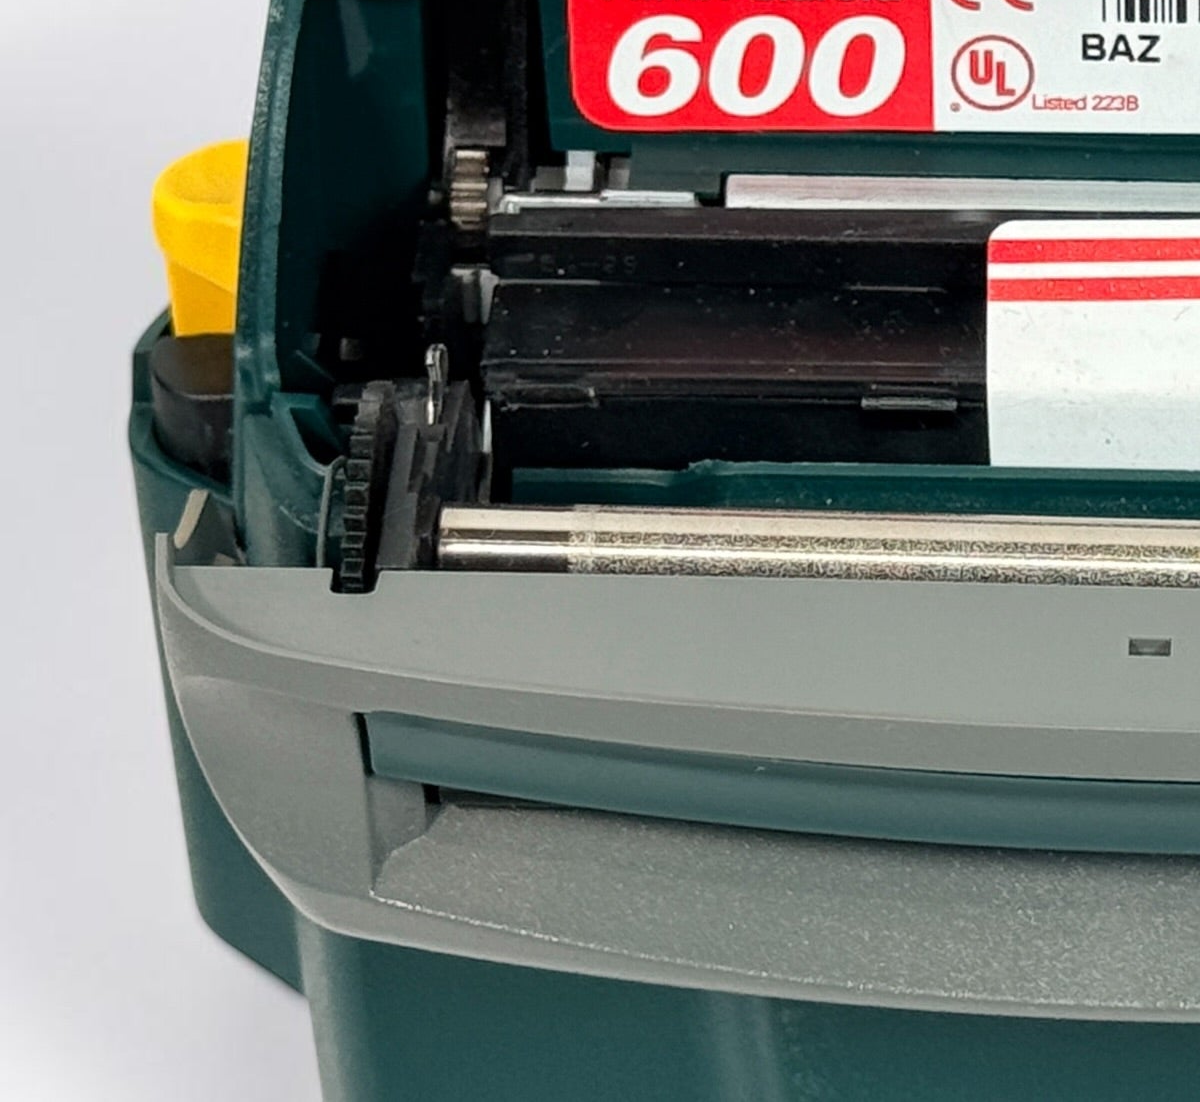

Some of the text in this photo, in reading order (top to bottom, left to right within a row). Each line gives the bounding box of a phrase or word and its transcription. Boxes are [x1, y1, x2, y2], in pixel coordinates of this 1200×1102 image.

[607, 14, 906, 117] 600
[1082, 34, 1161, 62] BAZ
[969, 50, 1016, 96] UL
[1032, 93, 1140, 111] Listed 223B
